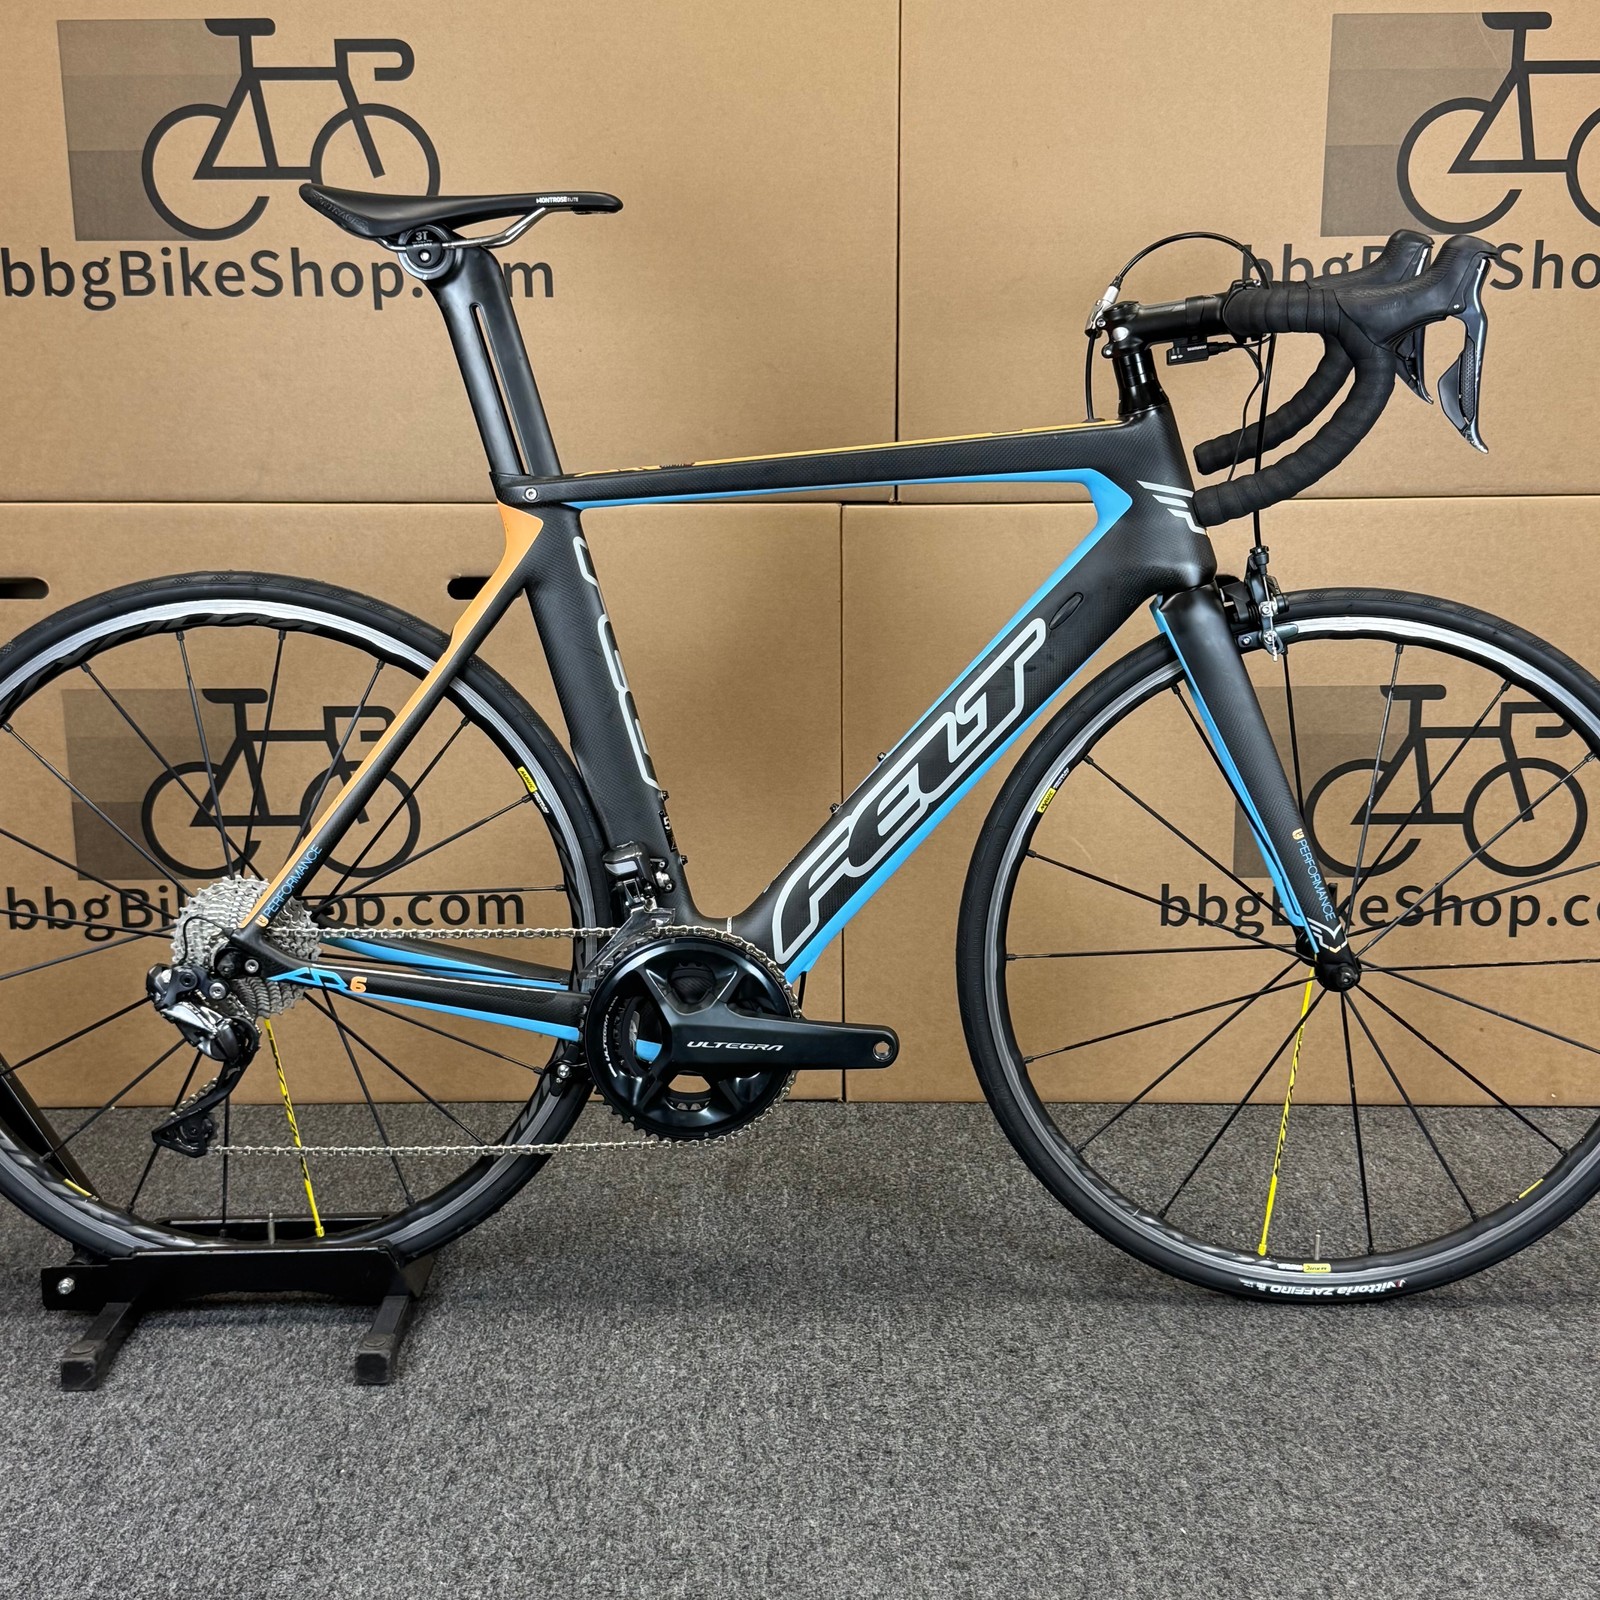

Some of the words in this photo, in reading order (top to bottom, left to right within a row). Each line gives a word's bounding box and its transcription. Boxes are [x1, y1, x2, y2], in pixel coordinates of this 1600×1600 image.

[4, 246, 554, 310] bbgBikeShop.m
[262, 846, 323, 921] PERFORMANCE
[1298, 839, 1337, 922] PERFORMANCE
[686, 1041, 784, 1051] ULTEGRA
[1270, 1285, 1334, 1296] ZAFFIRO
